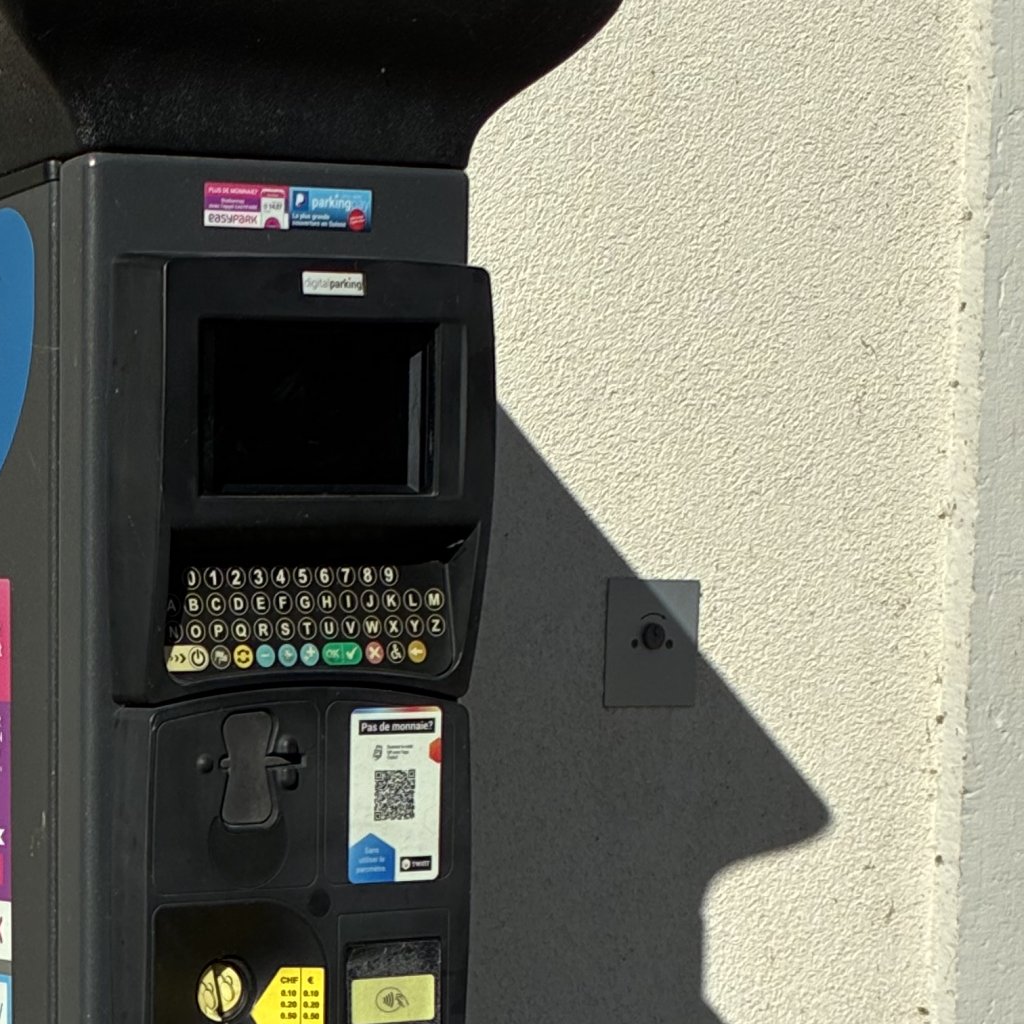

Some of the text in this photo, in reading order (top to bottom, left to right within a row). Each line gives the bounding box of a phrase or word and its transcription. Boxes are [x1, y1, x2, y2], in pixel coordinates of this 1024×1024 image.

[209, 570, 217, 586] 1
[231, 569, 241, 585] 2
[254, 569, 263, 585] 3
[276, 569, 286, 584] 4
[298, 568, 308, 584] 5
[319, 568, 330, 584] 6
[341, 568, 350, 583] 7
[363, 567, 373, 583] 8
[384, 567, 394, 583] 9
[188, 598, 199, 611] B
[211, 597, 221, 611] C
[233, 597, 244, 611] D
[256, 596, 266, 610] E
[278, 596, 287, 609] F
[299, 595, 311, 609] G
[322, 595, 332, 608] H
[346, 595, 351, 608] I
[366, 595, 374, 608] J
[386, 594, 396, 607] K
[408, 594, 417, 607] L
[428, 593, 440, 606] M
[190, 624, 202, 639] O
[214, 624, 224, 638] P
[235, 623, 247, 637] Q
[258, 623, 269, 636] R
[280, 622, 290, 636] S
[302, 622, 312, 635] T
[324, 621, 334, 635] U
[345, 621, 355, 634] V
[365, 620, 379, 634] W
[389, 620, 399, 633] X
[410, 619, 419, 632] Y
[431, 619, 441, 632] Z
[361, 720, 433, 732] Pas de monnaie?
[280, 976, 314, 985] CHF €
[280, 989, 319, 997] 0.10 0.10
[280, 1001, 320, 1009] 0.20 0.20
[280, 1012, 320, 1020] 0.50 0.50
